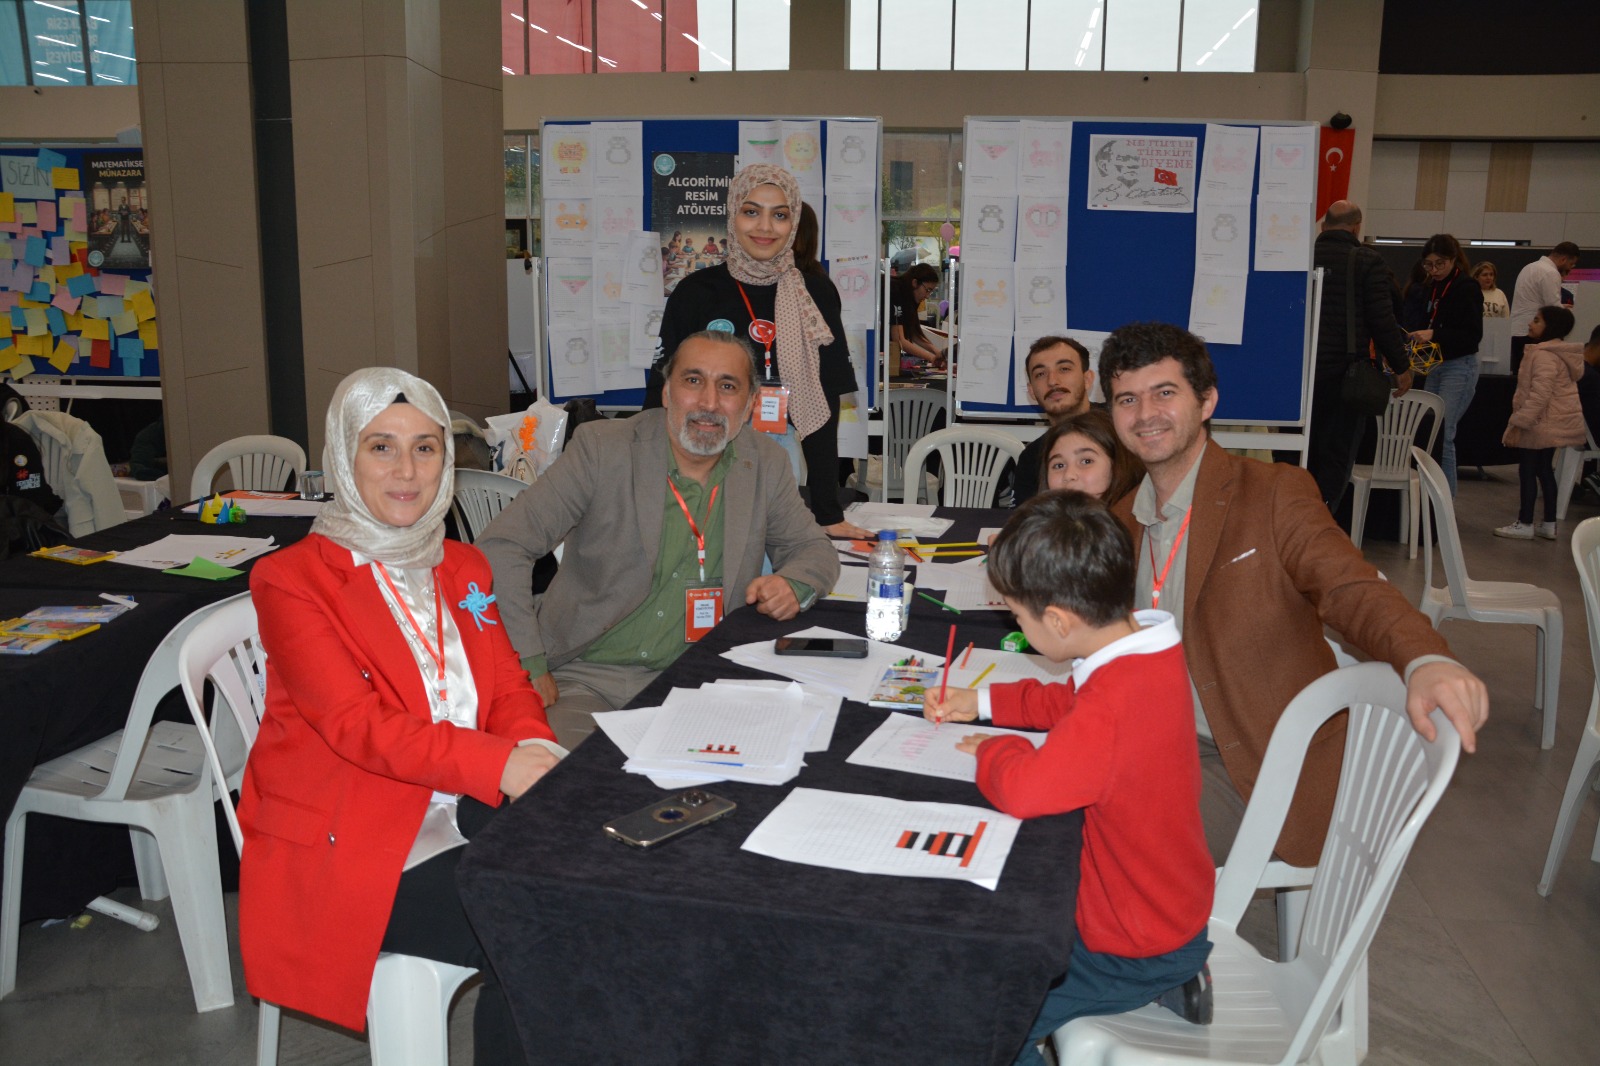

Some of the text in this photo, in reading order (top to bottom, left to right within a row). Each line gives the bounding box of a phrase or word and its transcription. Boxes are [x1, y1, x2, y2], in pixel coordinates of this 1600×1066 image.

[1126, 139, 1145, 147] NE
[98, 168, 142, 178] MÜNAZARA
[685, 189, 719, 201] RESİM
[676, 202, 727, 215] ATÖLYESİ
